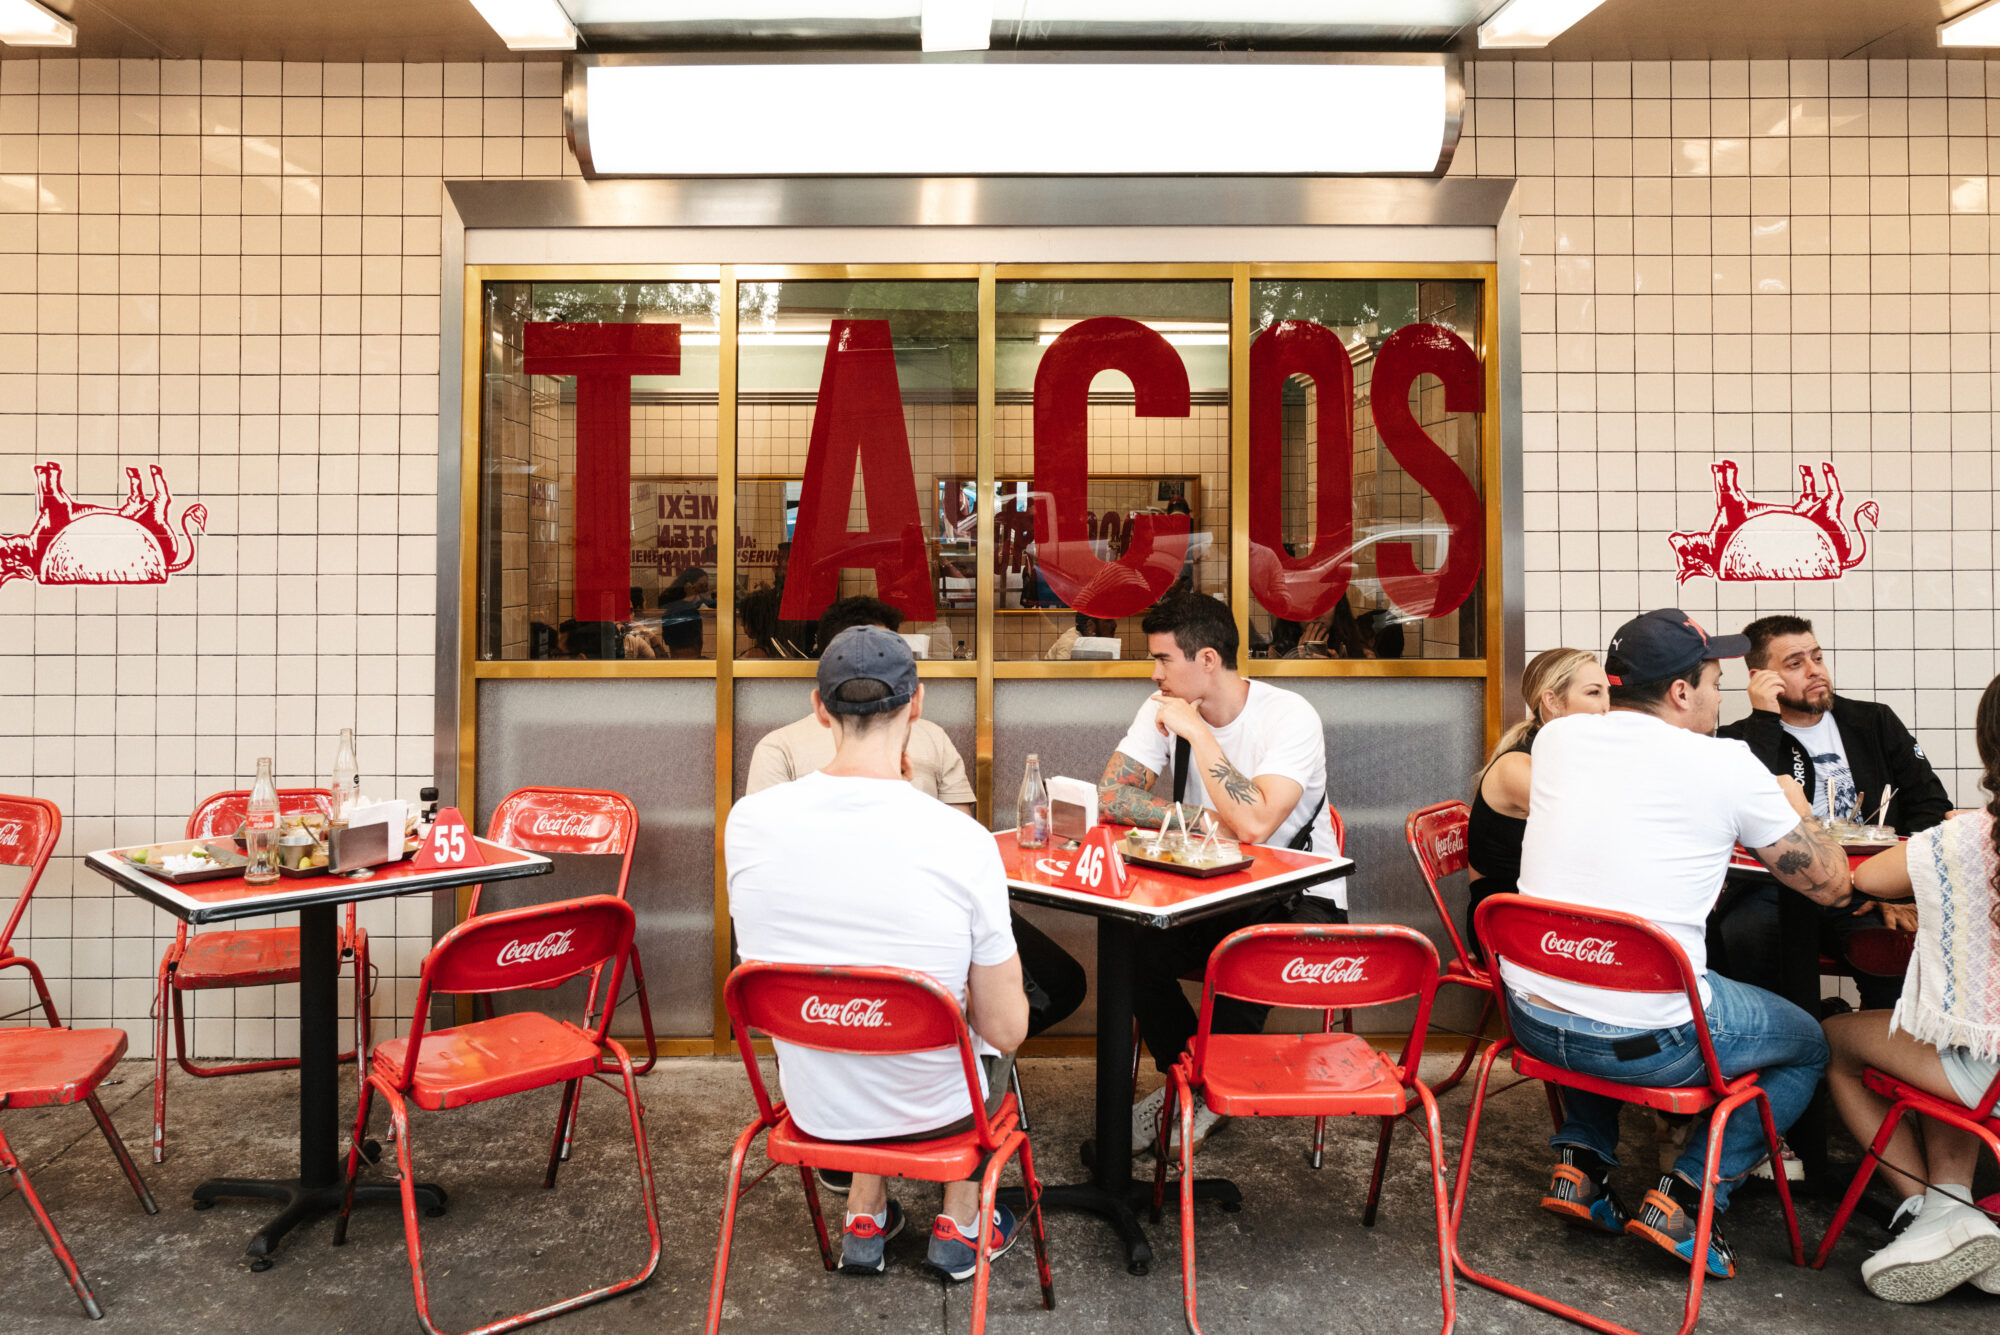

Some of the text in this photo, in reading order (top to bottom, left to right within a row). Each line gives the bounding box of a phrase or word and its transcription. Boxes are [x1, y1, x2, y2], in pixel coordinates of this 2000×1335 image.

[523, 315, 1483, 623] TACOS
[434, 824, 466, 863] 55
[1075, 844, 1105, 887] 46
[496, 928, 576, 967] Coca-Cola
[1541, 931, 1618, 965] Coca-Cola
[1281, 956, 1369, 984] Coca-Cola
[800, 995, 888, 1027] Coca-Cola
[855, 1222, 872, 1231] NIKE
